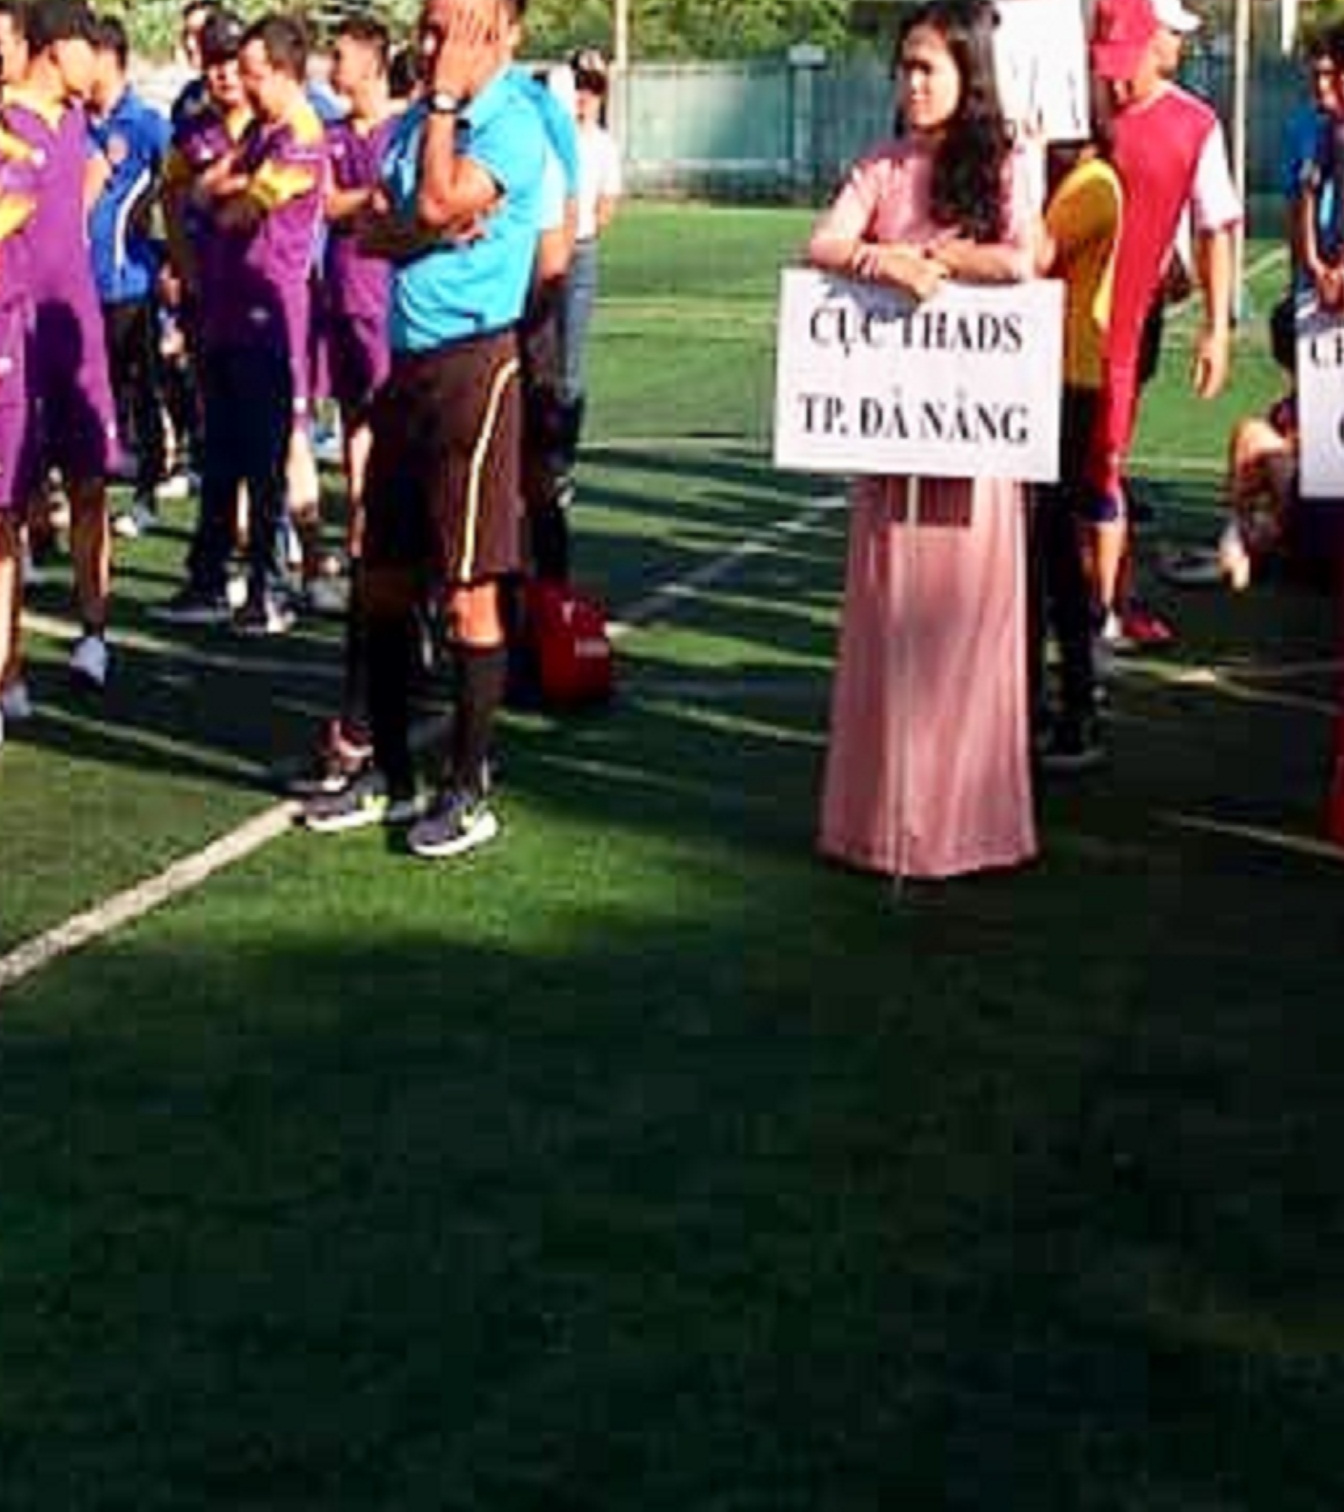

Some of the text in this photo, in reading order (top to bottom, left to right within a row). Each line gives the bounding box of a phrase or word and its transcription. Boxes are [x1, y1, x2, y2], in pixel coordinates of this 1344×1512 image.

[810, 307, 1024, 358] CỤC THADS
[797, 391, 848, 435] TP.
